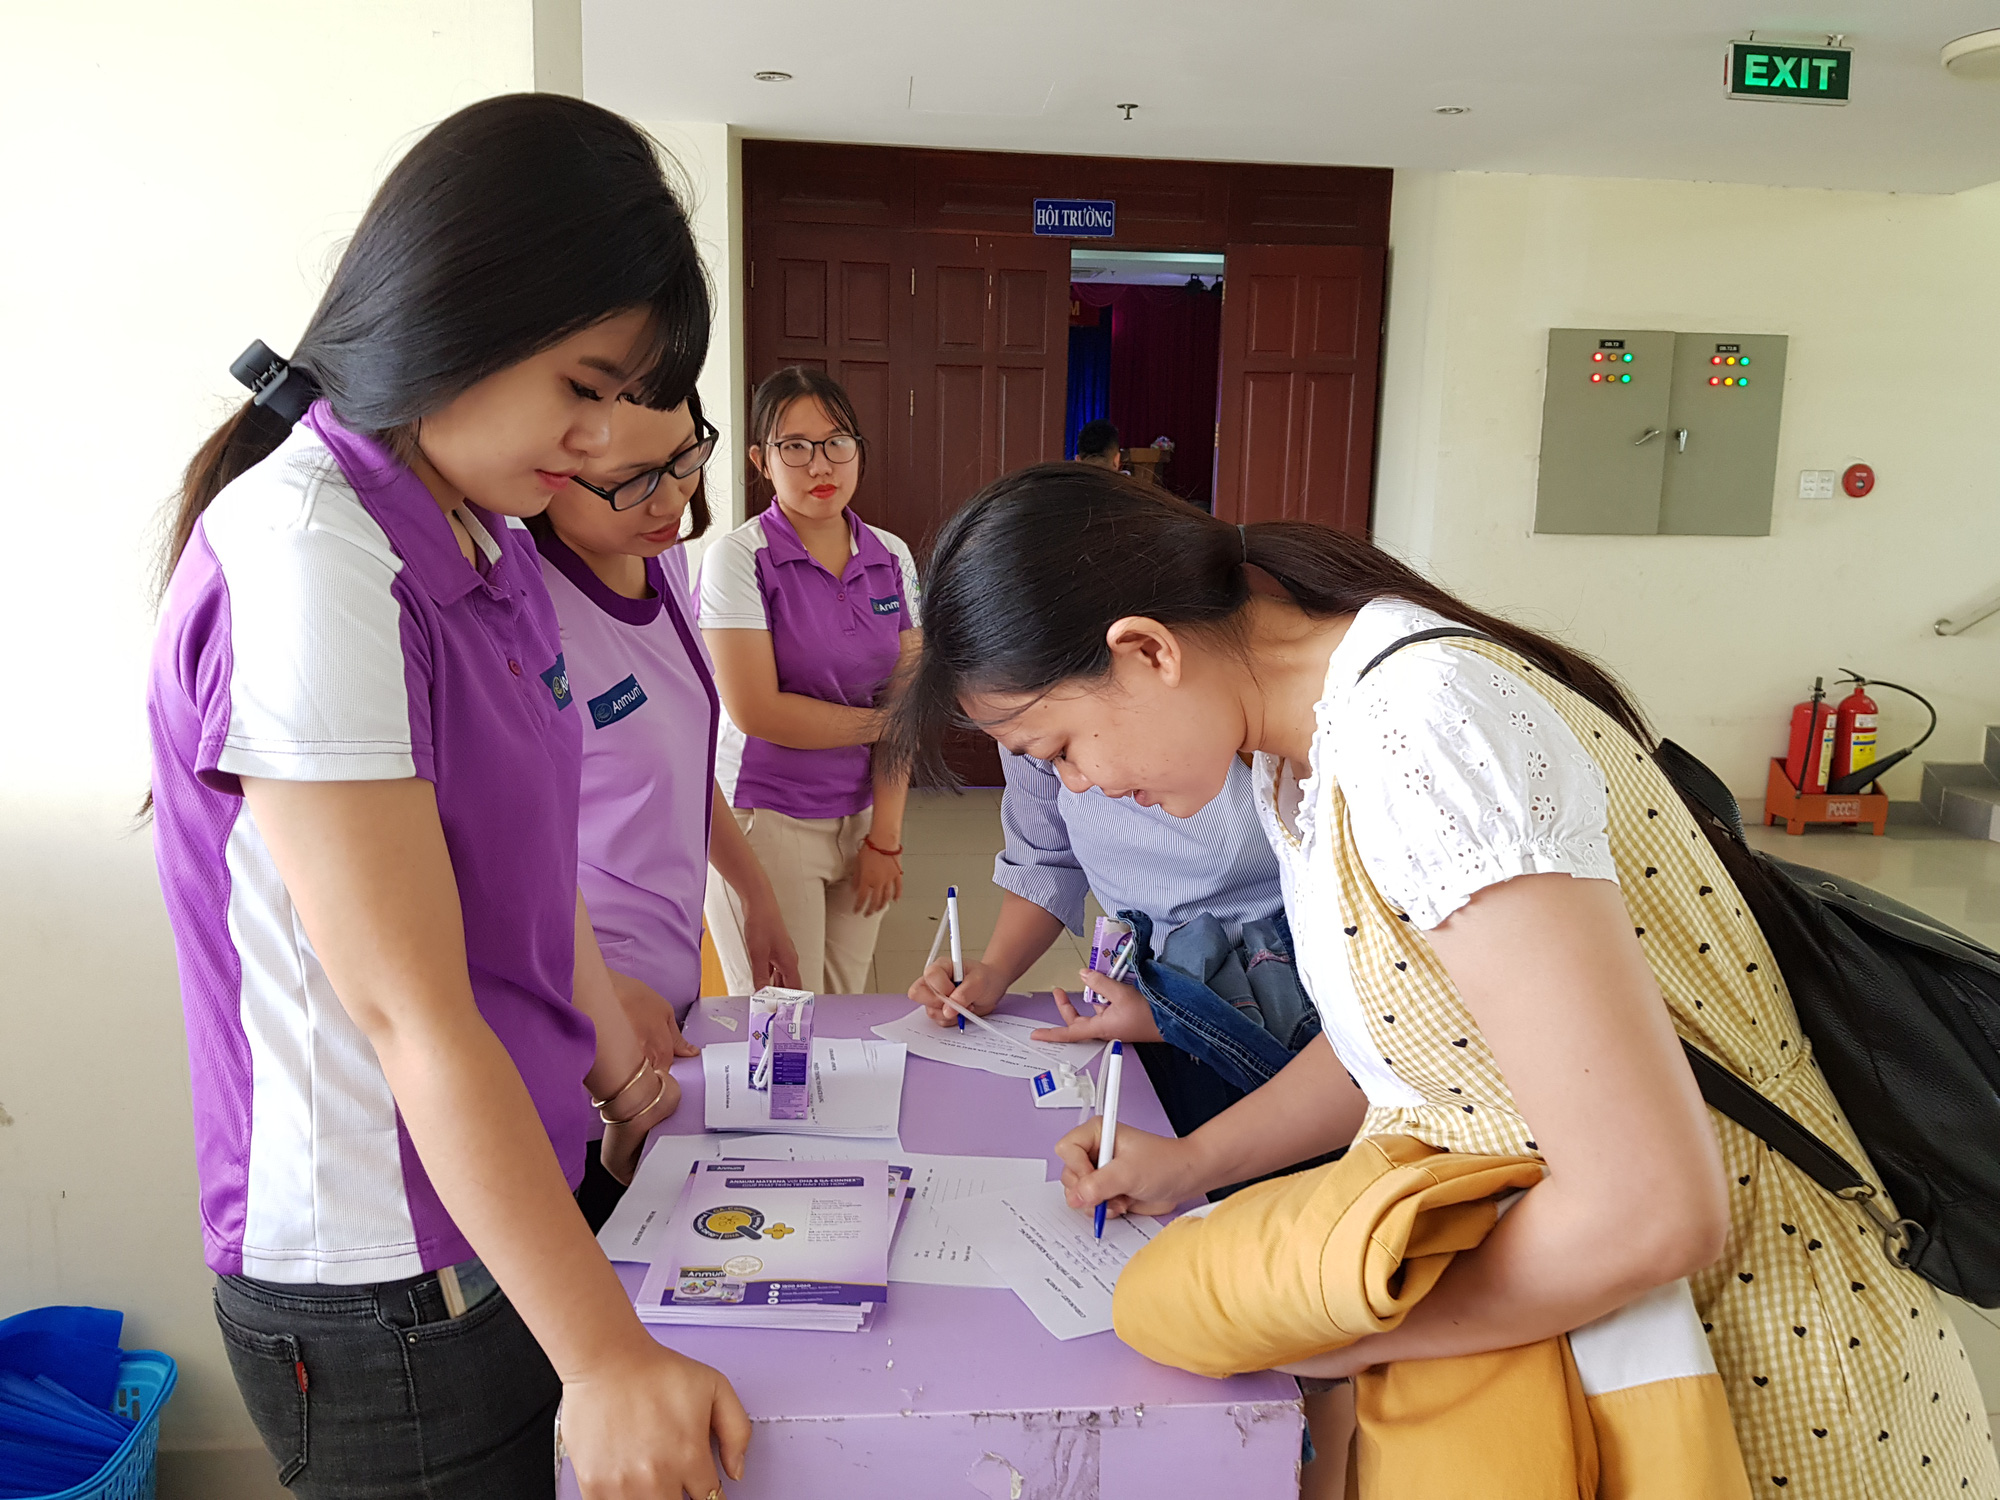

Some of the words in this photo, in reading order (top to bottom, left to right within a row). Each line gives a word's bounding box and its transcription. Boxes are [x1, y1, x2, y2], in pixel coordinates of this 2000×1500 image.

[1745, 54, 1837, 90] EXIT
[1037, 204, 1059, 230] HỘI
[1062, 205, 1112, 228] TRƯỜNG
[879, 601, 900, 612] Anm
[612, 686, 642, 714] Anmum
[1828, 802, 1852, 817] PCCC
